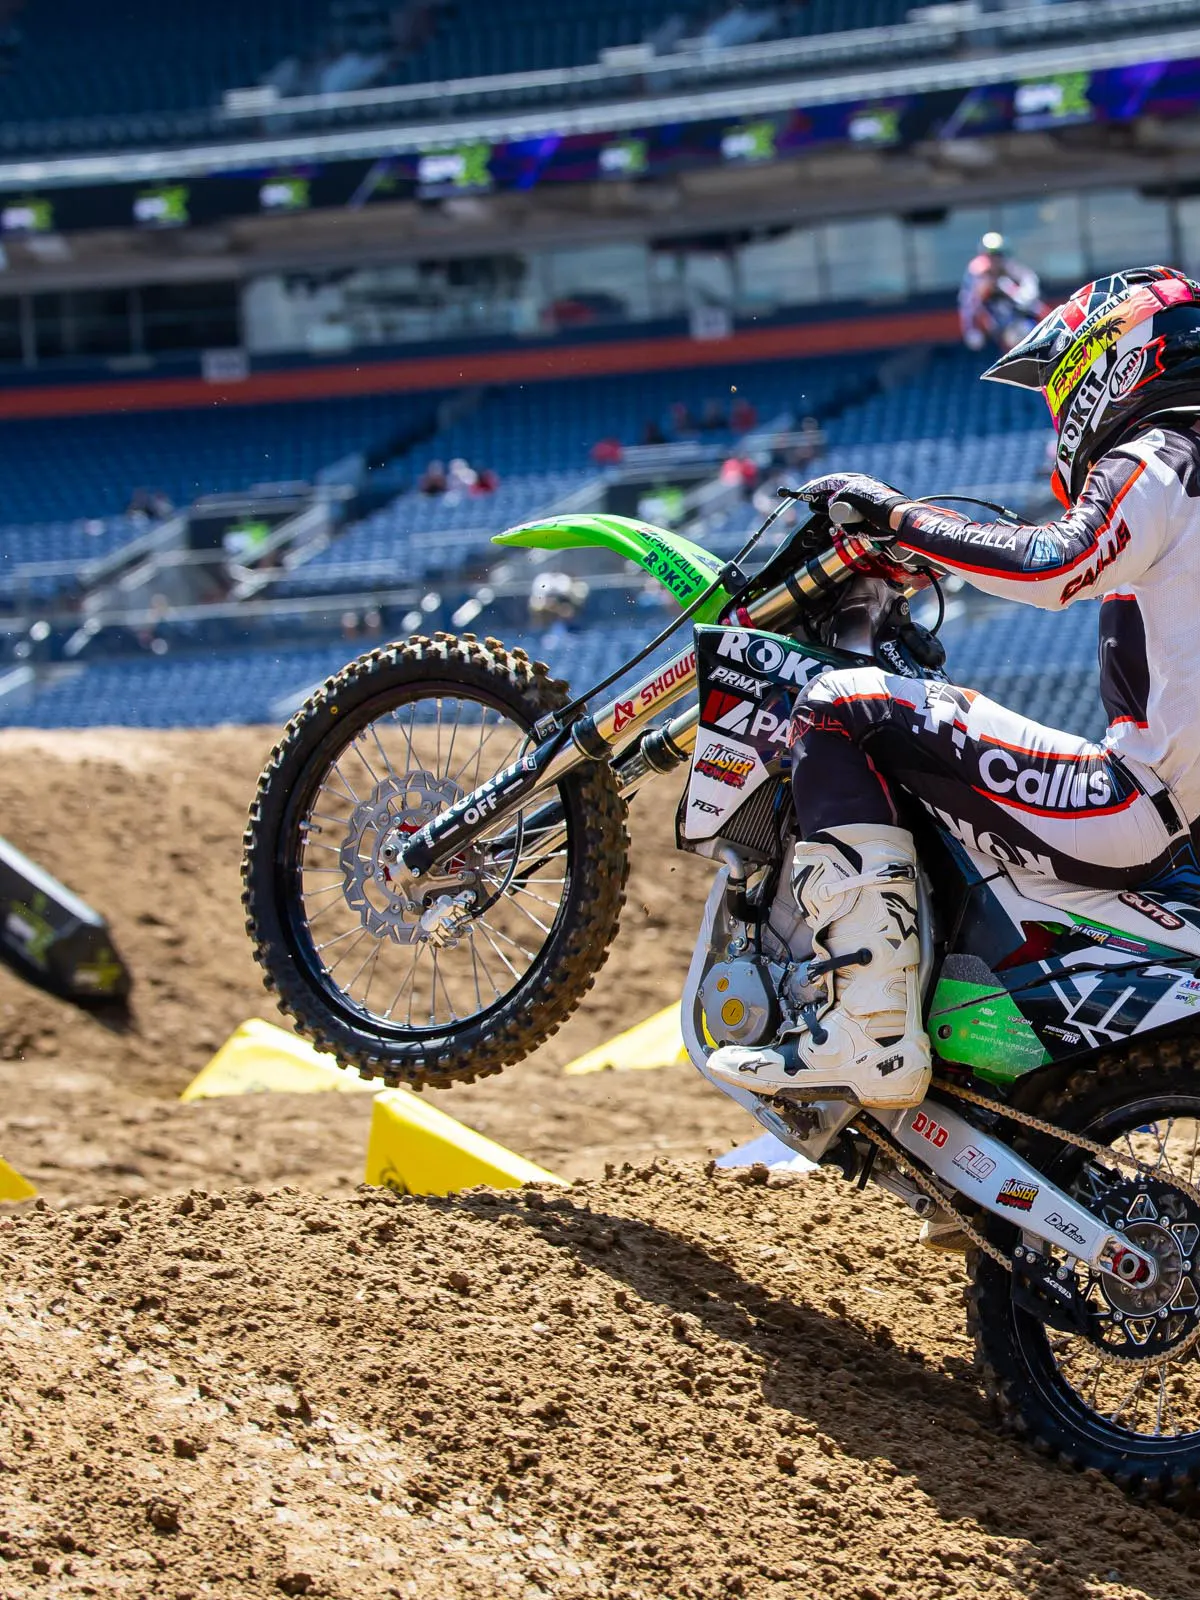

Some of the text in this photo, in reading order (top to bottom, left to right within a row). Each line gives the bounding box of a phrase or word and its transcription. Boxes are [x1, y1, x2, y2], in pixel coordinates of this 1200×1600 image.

[937, 521, 1017, 551] PARTZILLA
[642, 551, 693, 598] ROKiT
[708, 665, 774, 699] PRMX
[702, 744, 756, 776] BLASTER
[979, 749, 1112, 808] Callus
[464, 791, 497, 825] OFF
[1121, 892, 1179, 926] GUTS
[1001, 1179, 1039, 1201] BLASTER
